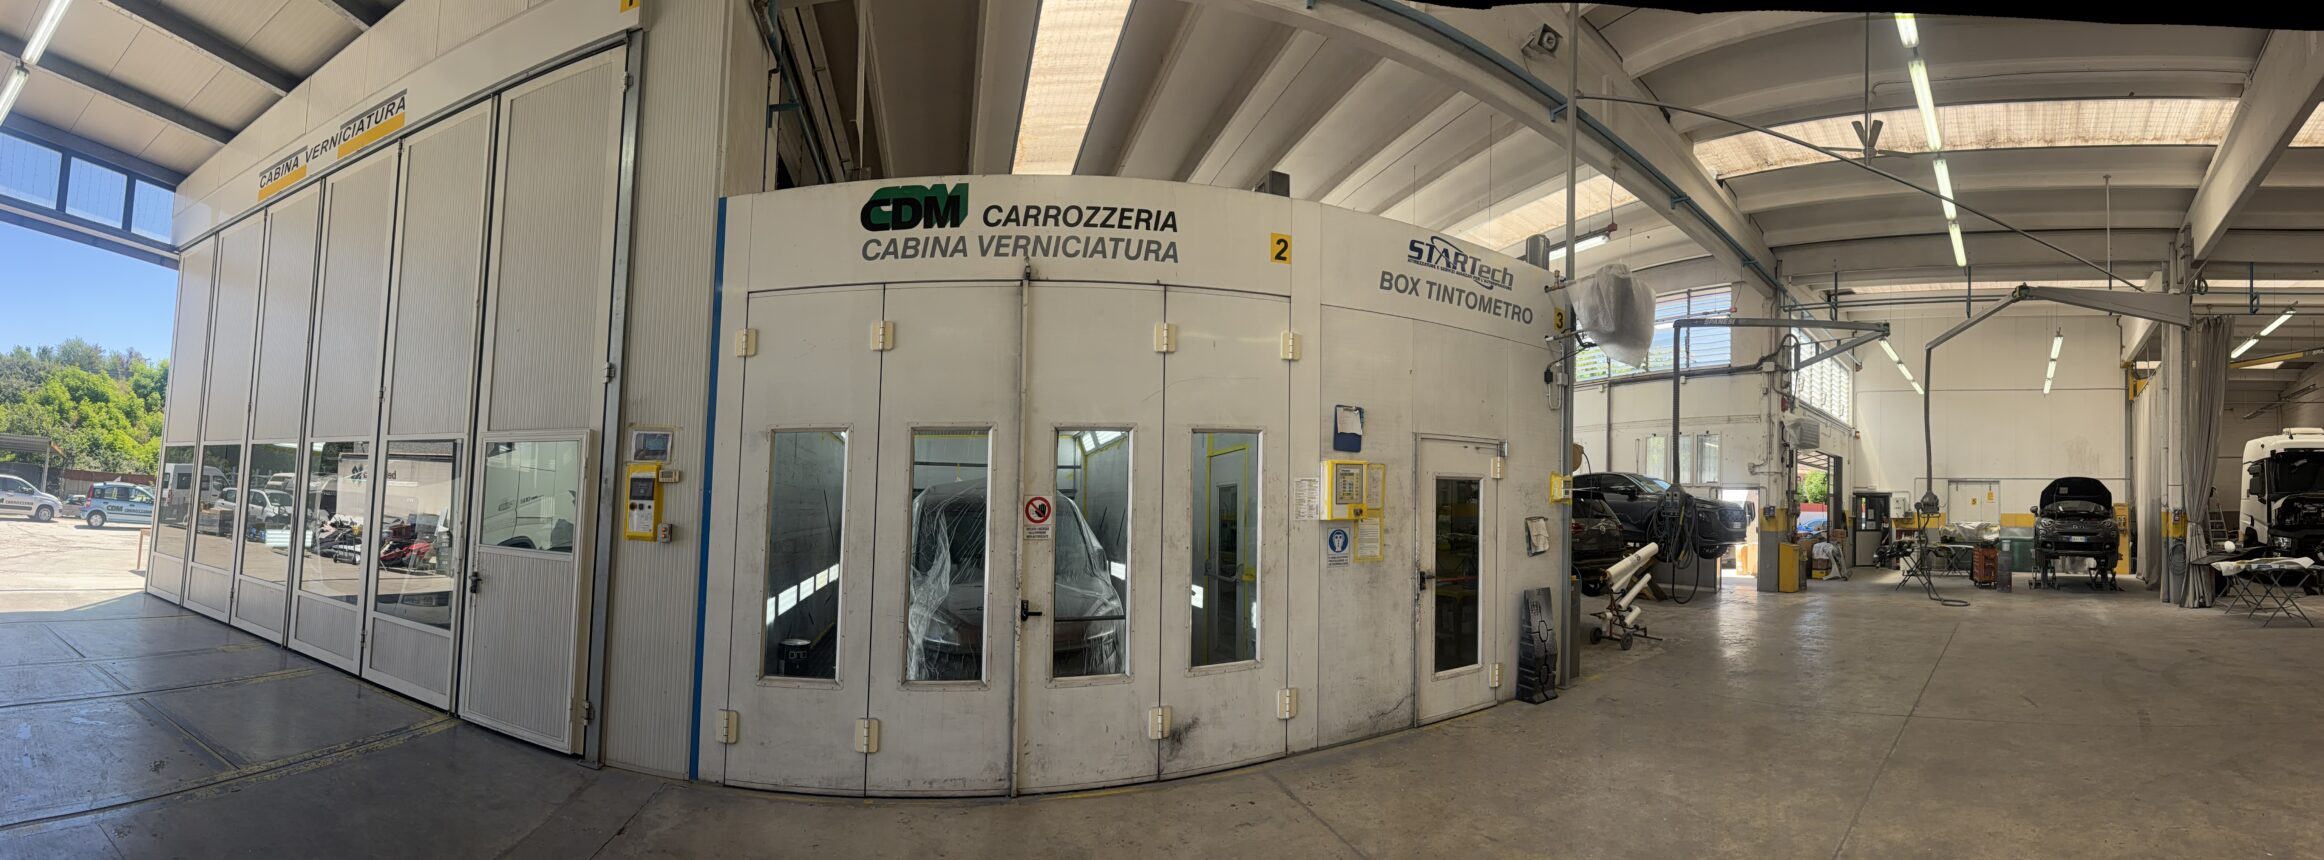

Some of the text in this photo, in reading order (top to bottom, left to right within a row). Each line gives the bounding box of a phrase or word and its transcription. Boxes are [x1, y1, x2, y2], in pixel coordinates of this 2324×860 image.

[260, 96, 405, 188] CABINA VERNICIATURA
[860, 187, 1178, 232] CDM CARROZZERIA
[862, 235, 1179, 263] CABINA VERNICIATURA
[1275, 238, 1289, 261] 2
[1407, 239, 1514, 286] STARTech
[1379, 270, 1533, 324] BOX TINTOMETRO
[1556, 311, 1564, 329] 3
